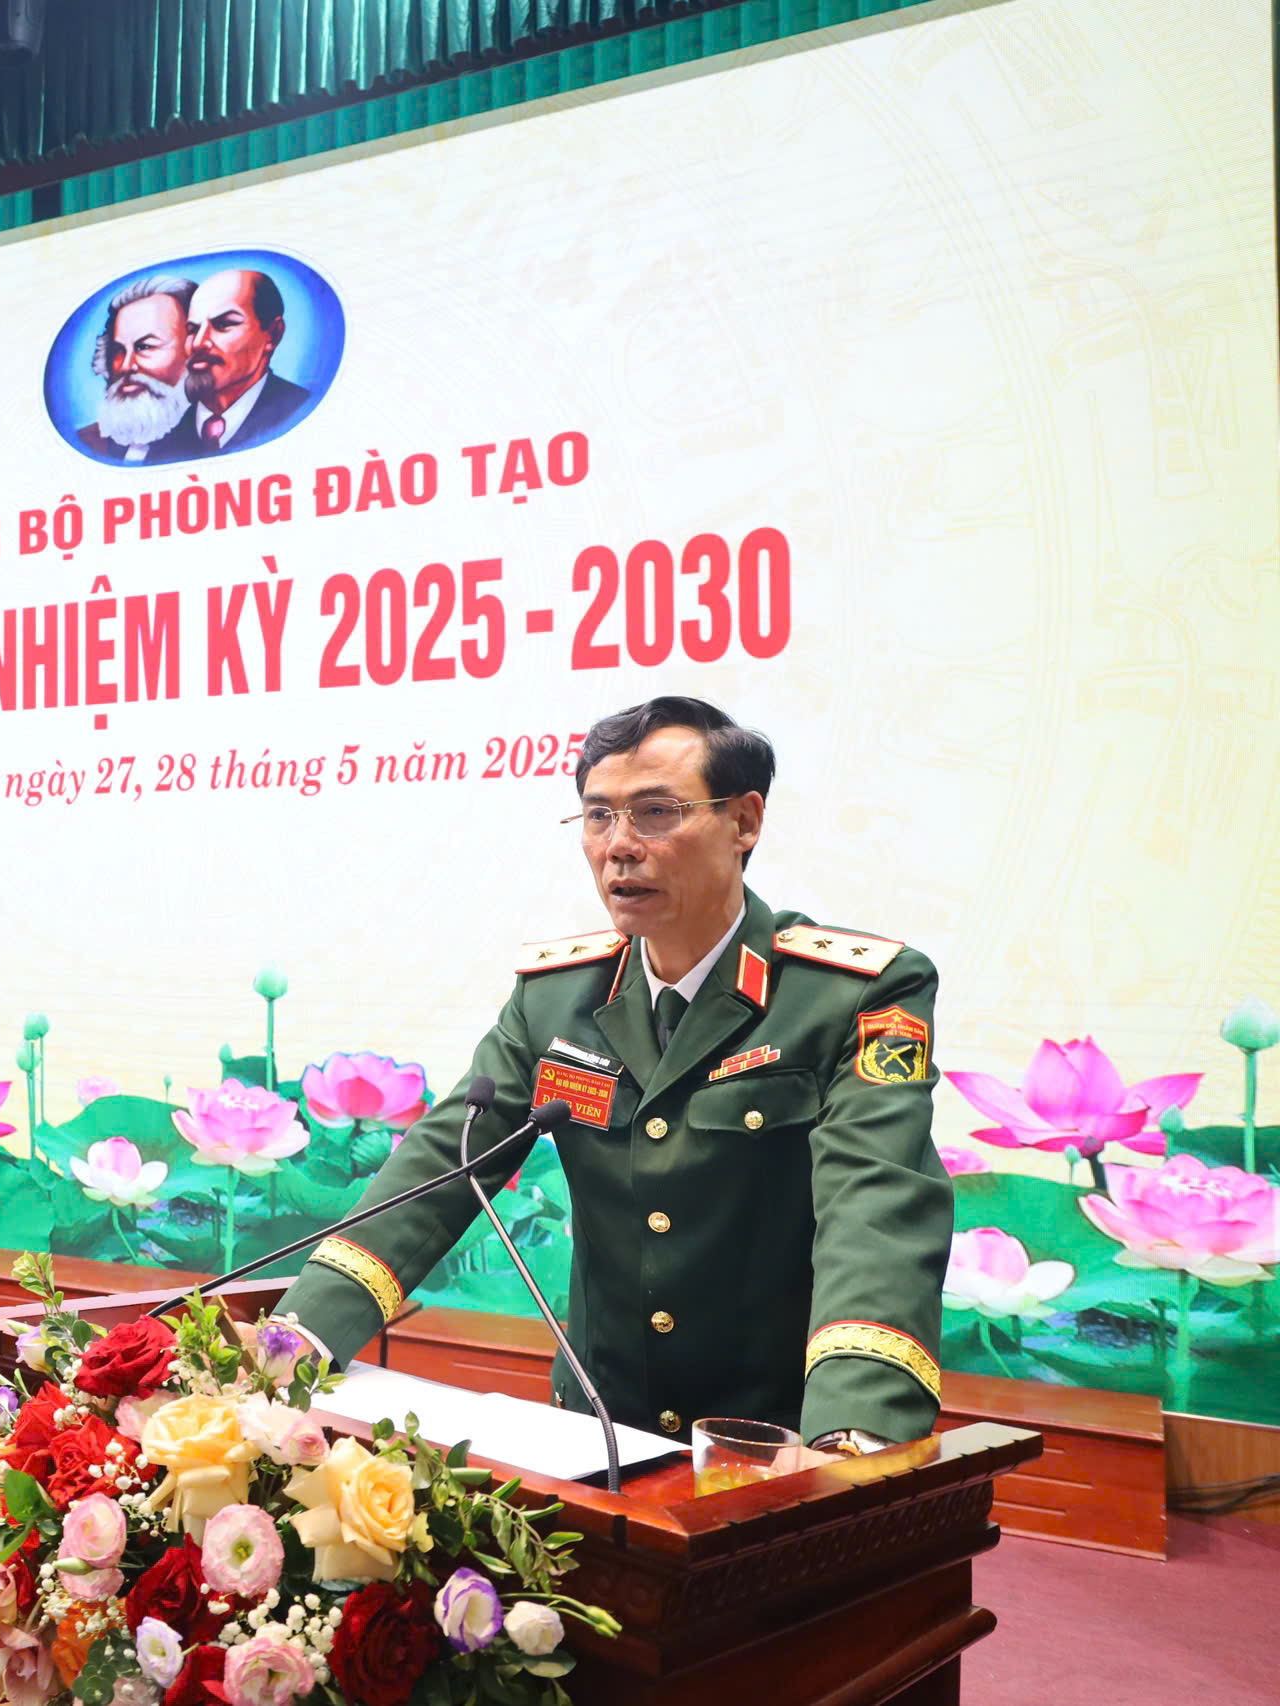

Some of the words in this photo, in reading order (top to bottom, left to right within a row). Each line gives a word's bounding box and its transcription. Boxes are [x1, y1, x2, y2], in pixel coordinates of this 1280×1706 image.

[19, 493, 84, 561] BỘ
[103, 473, 293, 545] PHÒNG
[312, 449, 438, 518] ĐÀO
[461, 431, 590, 505] TẠO
[207, 555, 294, 697] KỲ
[319, 557, 506, 689] 2025
[571, 526, 792, 671] 2030
[4, 760, 86, 807] ngày
[95, 755, 143, 799] 27,
[154, 753, 197, 792] 28
[210, 745, 327, 797] tháng
[336, 744, 361, 785] 5
[375, 743, 468, 783] năm
[481, 733, 587, 779] 2025
[575, 1102, 602, 1119] VIÊN
